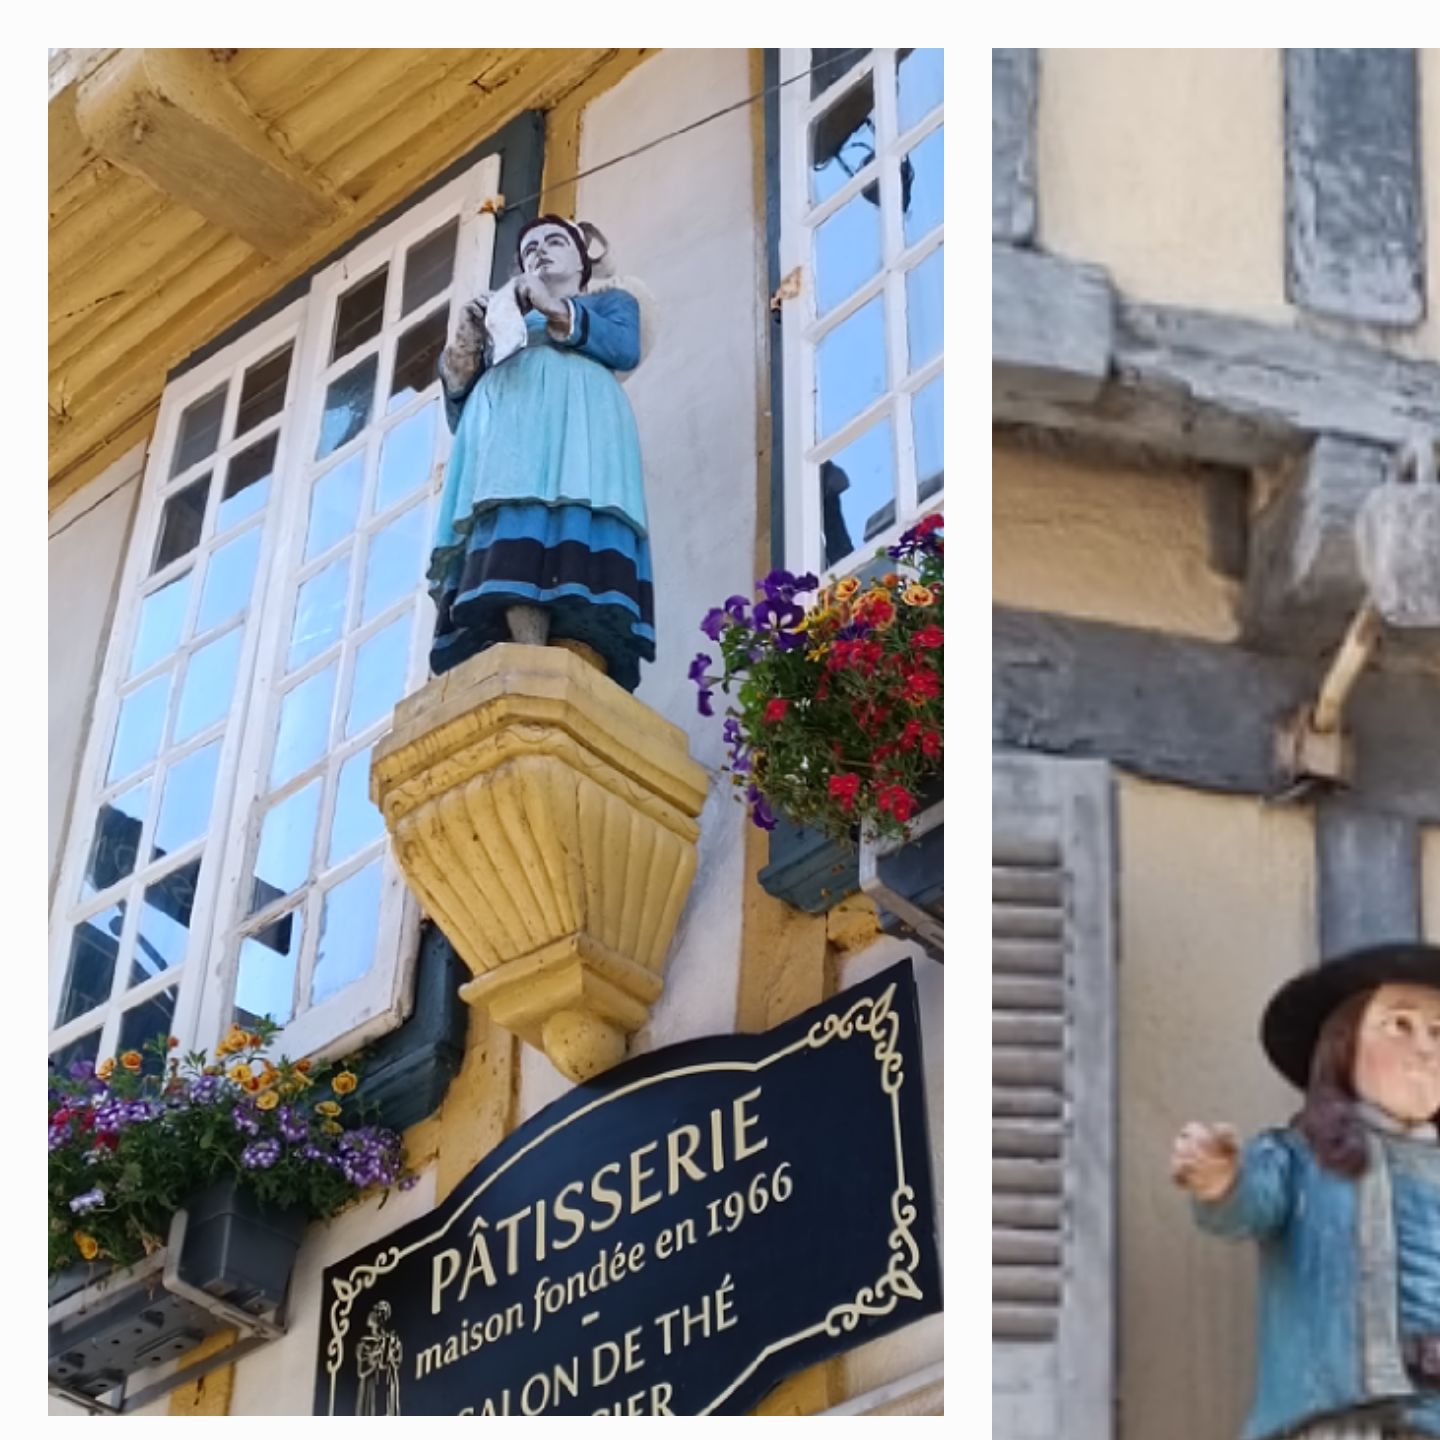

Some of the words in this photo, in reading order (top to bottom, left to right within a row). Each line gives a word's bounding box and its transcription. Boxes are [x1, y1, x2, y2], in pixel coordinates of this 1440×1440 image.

[416, 1301, 525, 1380] maison
[532, 1240, 646, 1333] fondée
[654, 1217, 698, 1260] en
[706, 1161, 794, 1238] 1966
[431, 1085, 768, 1315] PÂTISSERIE
[591, 1325, 646, 1387] DE
[653, 1272, 739, 1355] THÉ
